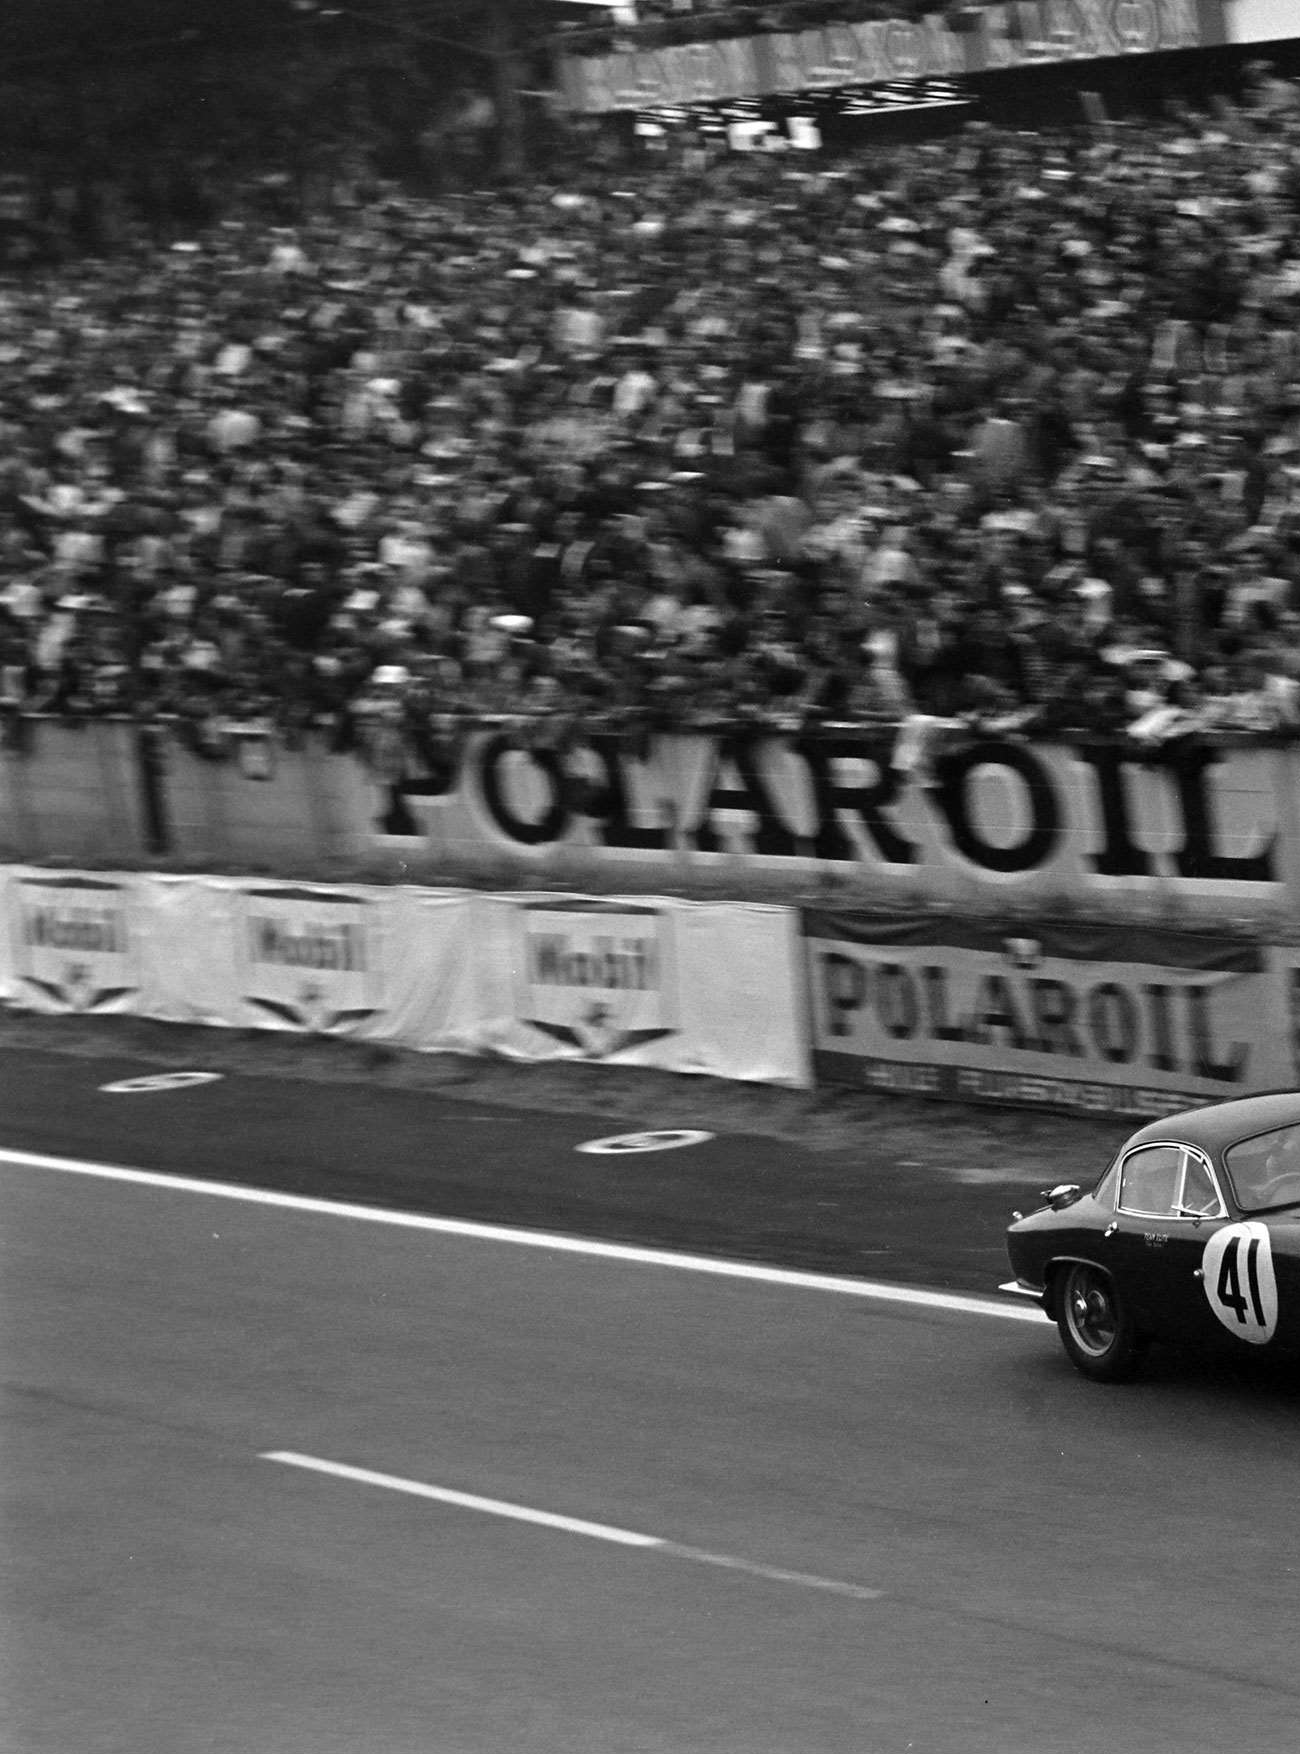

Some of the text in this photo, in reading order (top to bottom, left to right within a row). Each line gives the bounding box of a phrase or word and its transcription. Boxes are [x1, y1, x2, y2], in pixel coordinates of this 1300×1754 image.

[382, 722, 1280, 881] POLAROIL
[523, 931, 662, 991] Mobil
[820, 951, 1252, 1083] POLAROIL
[1217, 1236, 1267, 1327] 41
